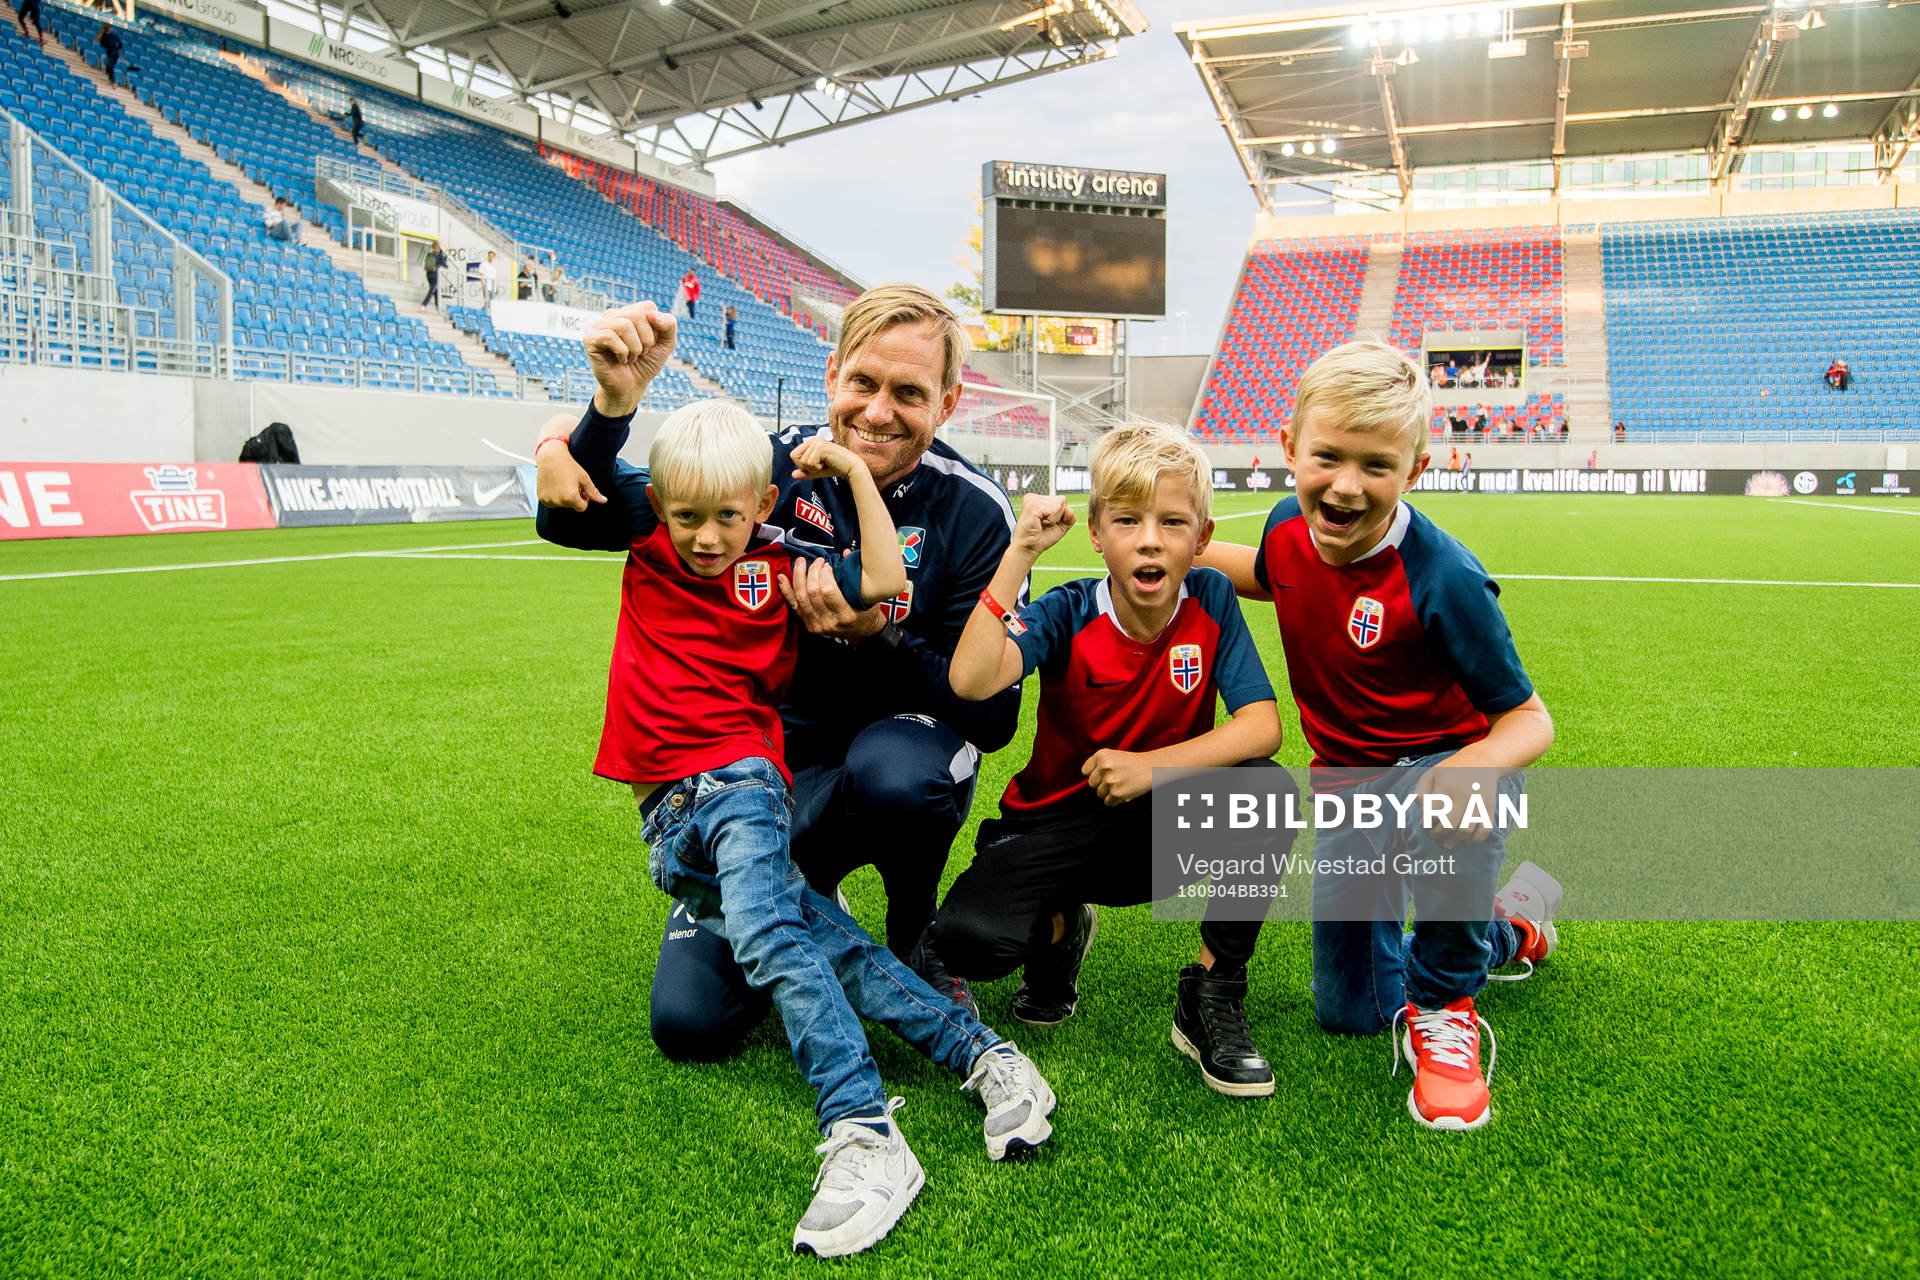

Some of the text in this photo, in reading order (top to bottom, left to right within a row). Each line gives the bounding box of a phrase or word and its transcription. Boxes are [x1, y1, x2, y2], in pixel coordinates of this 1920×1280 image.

[1007, 162, 1157, 197] intility arena
[1479, 468, 1518, 491] med
[1522, 468, 1637, 494] kvalifisering
[1642, 468, 1664, 491] til
[1669, 468, 1707, 492] VM!
[275, 477, 461, 512] NIKE.COM/FOOTBALL
[144, 496, 218, 522] TINE
[668, 928, 698, 941] telenor
